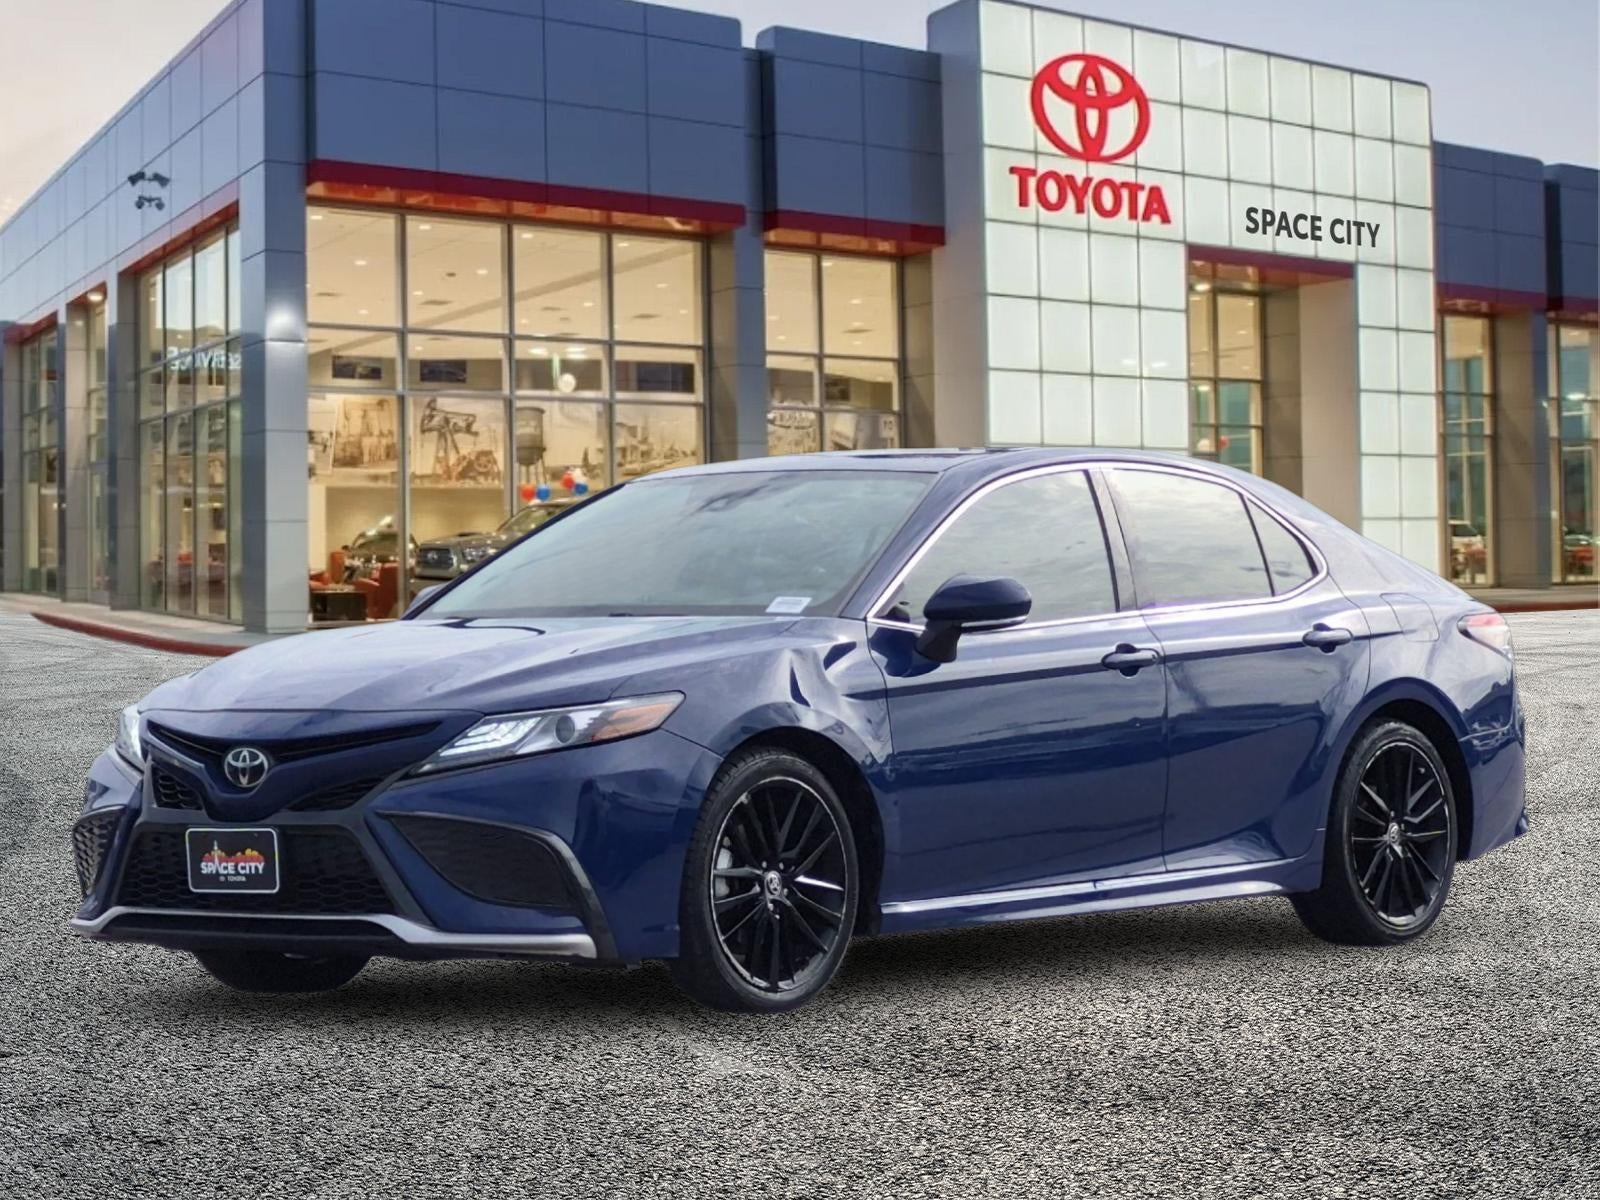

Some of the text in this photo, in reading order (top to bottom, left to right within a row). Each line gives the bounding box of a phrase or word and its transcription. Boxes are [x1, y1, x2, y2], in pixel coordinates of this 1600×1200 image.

[1009, 166, 1171, 224] TOYOTA
[1245, 206, 1380, 248] SPACE CITY
[201, 861, 264, 875] SPACE CITY
